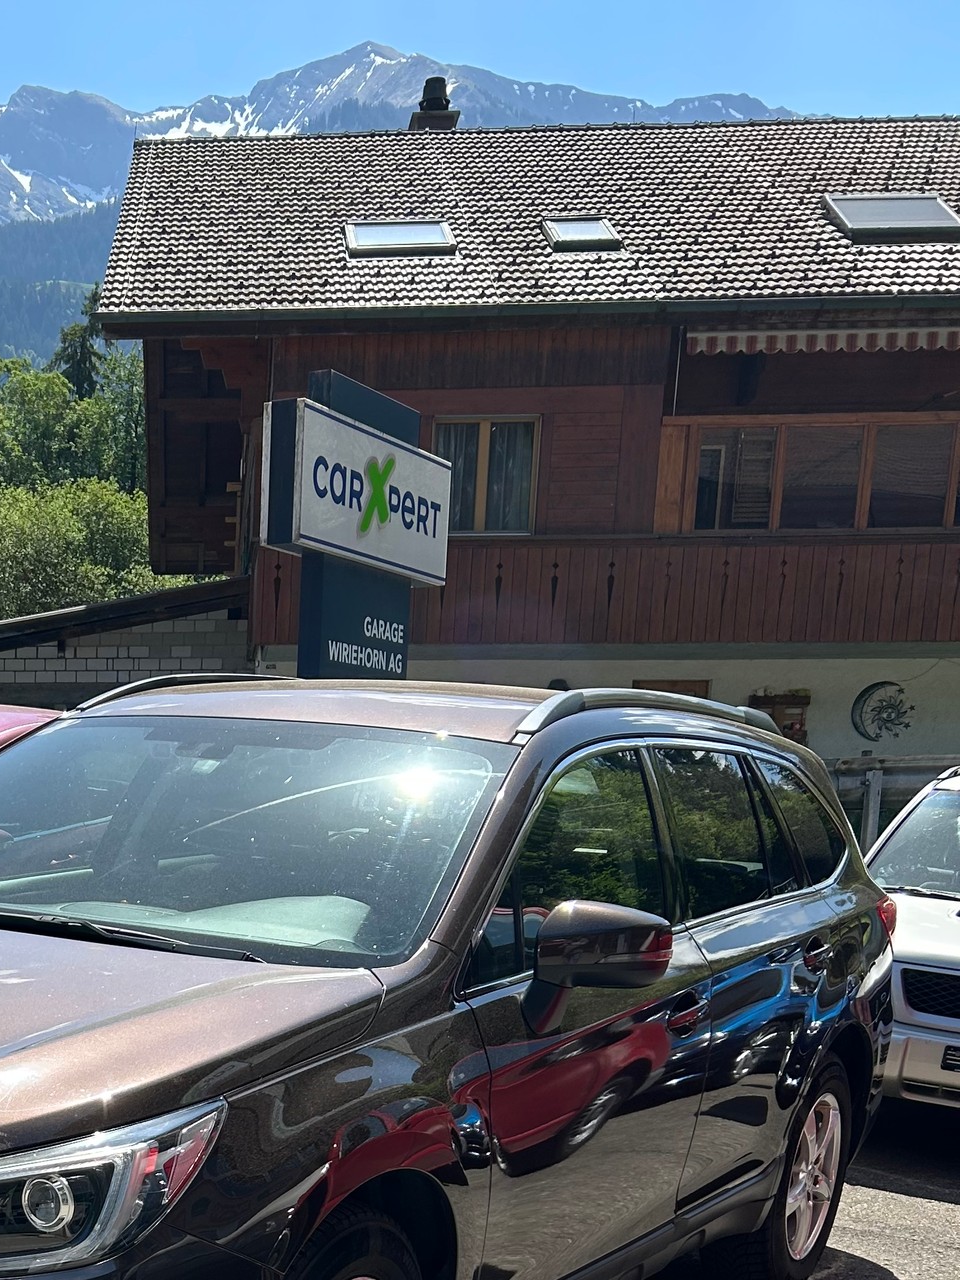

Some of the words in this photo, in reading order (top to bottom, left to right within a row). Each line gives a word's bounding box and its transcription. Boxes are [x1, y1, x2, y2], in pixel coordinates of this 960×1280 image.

[364, 616, 404, 644] GARAGE
[328, 640, 387, 671] WIRIEHORN
[387, 653, 403, 674] AG
